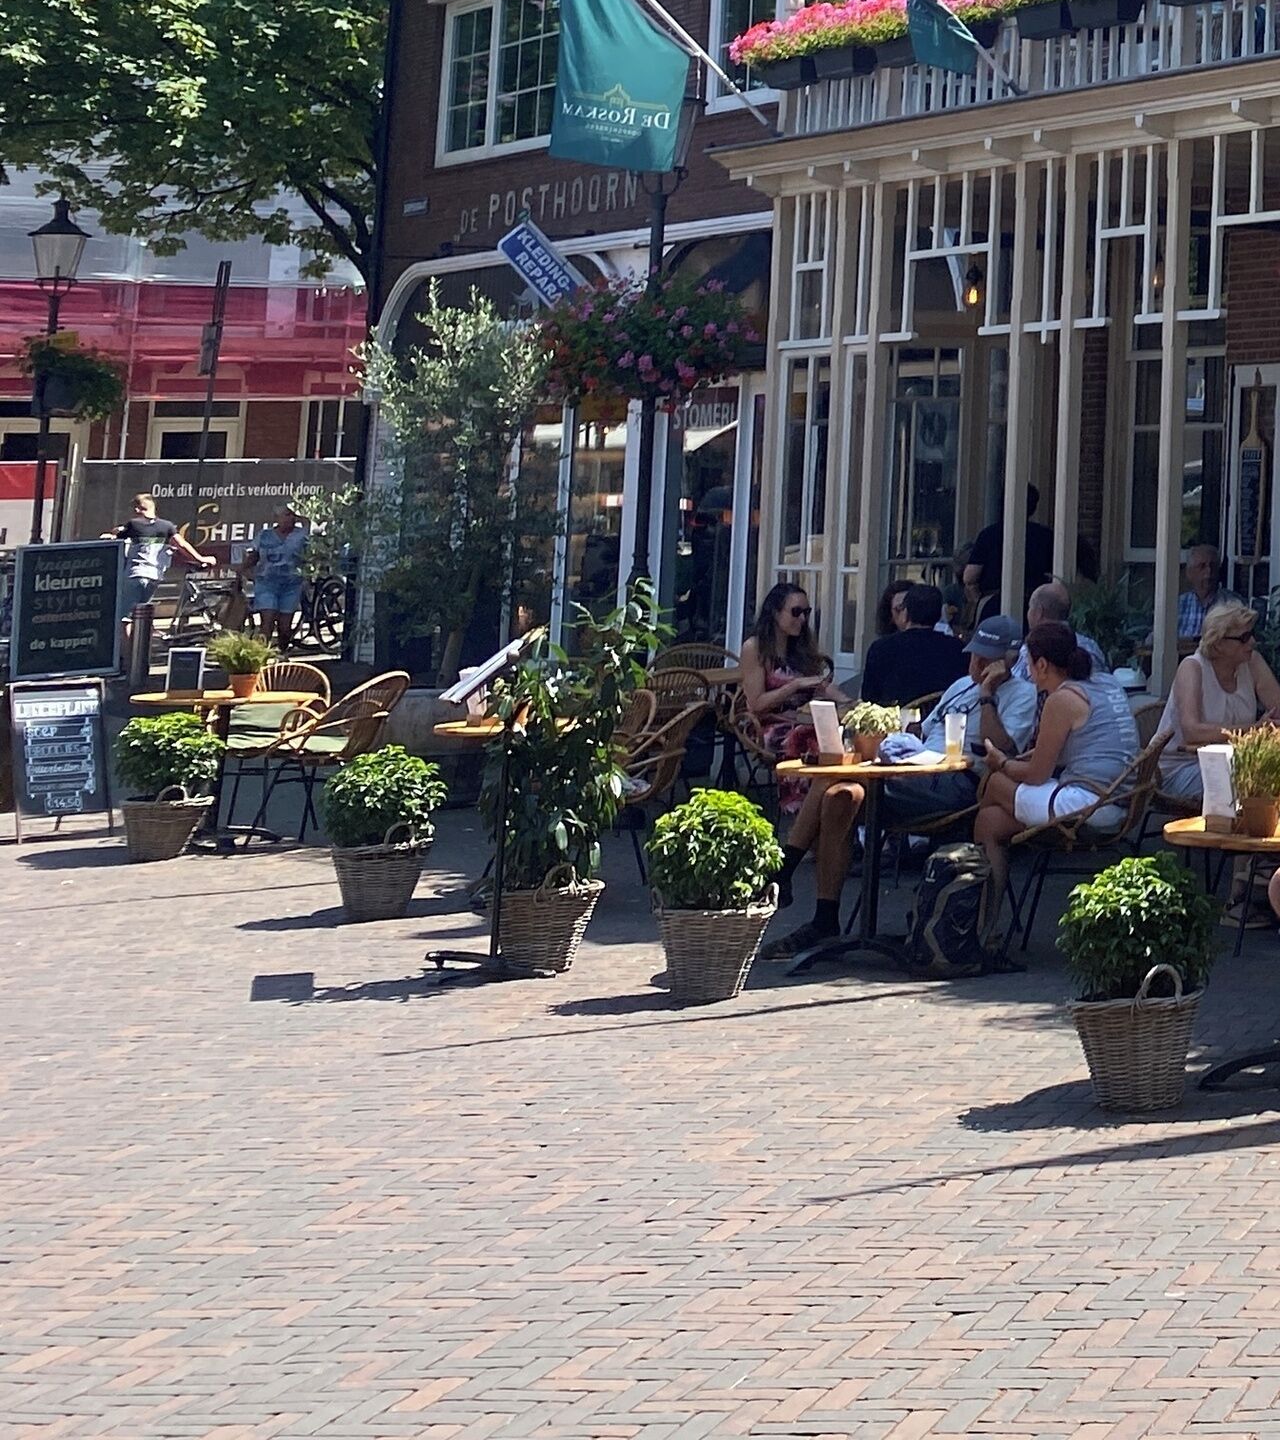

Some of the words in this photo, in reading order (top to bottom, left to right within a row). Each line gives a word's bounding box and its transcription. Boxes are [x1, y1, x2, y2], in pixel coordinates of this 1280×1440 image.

[487, 170, 638, 230] POSTHOORN
[516, 230, 571, 291] KLEDING-
[152, 484, 174, 498] Ook
[177, 483, 193, 498] dit
[236, 484, 246, 498] is
[248, 482, 294, 498] verkocht
[34, 574, 103, 592] kleuren
[32, 592, 101, 613] stylen
[29, 639, 46, 651] de
[50, 636, 94, 651] kapper
